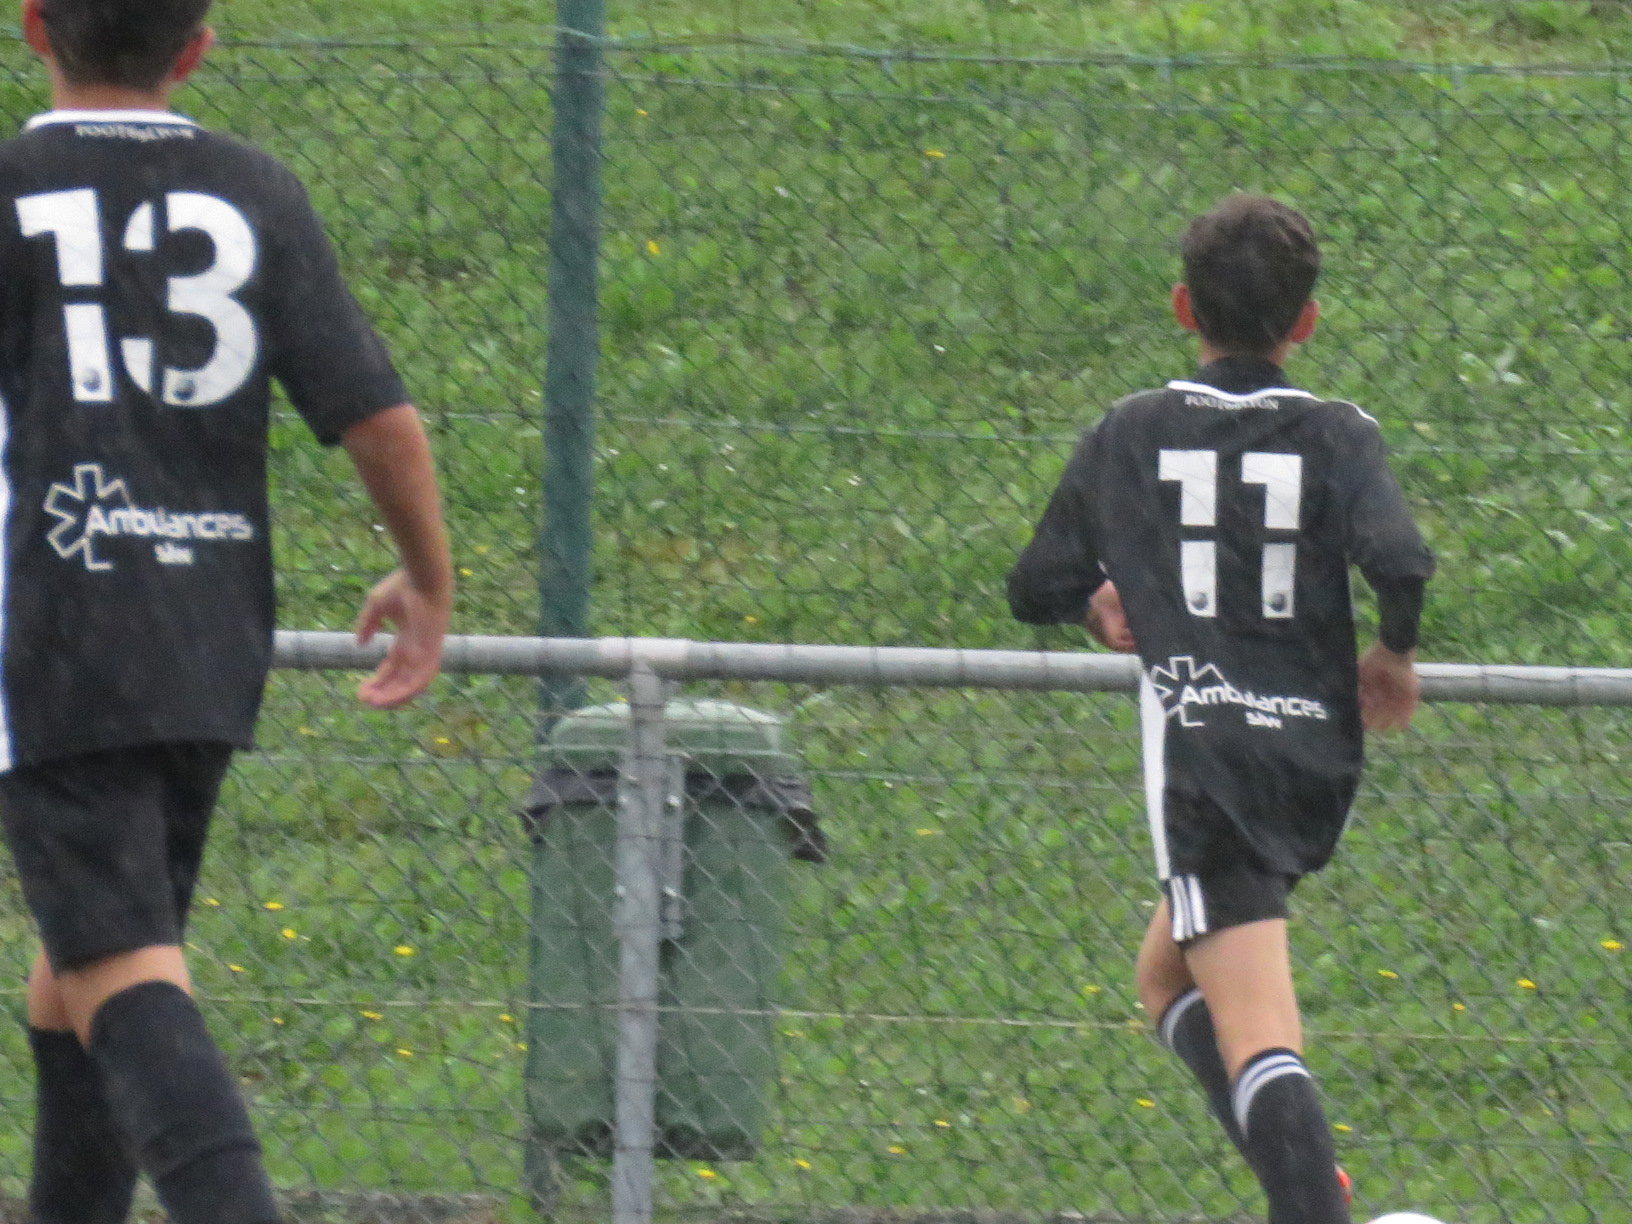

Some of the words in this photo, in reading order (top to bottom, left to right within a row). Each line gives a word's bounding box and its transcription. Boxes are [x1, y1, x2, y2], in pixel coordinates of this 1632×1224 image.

[15, 188, 258, 407] 13
[1157, 448, 1303, 619] 11
[1179, 684, 1329, 721] Ambulances
